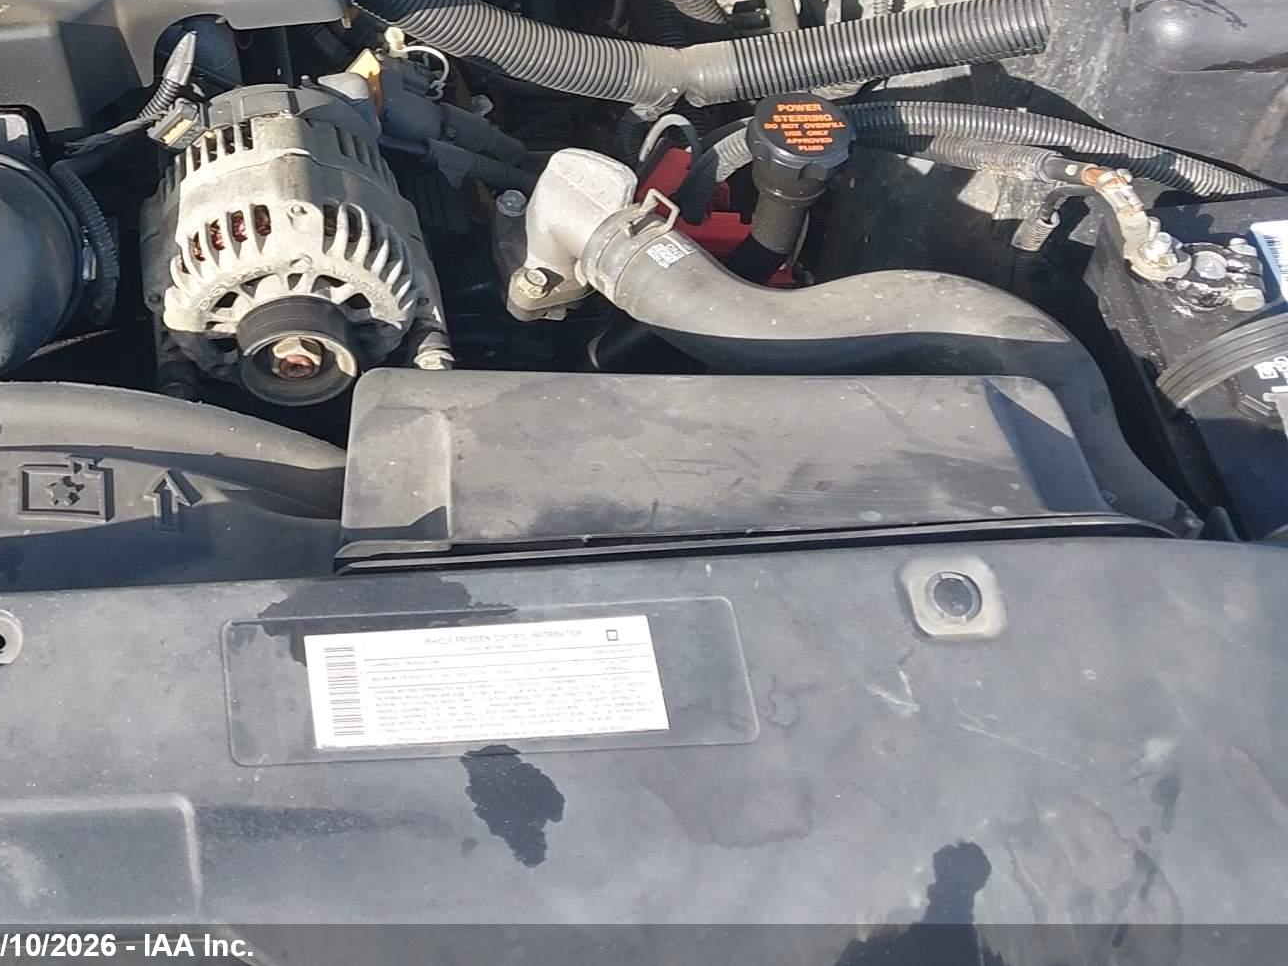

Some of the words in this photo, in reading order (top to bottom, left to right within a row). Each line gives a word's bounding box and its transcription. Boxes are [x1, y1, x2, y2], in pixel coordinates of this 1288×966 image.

[777, 103, 822, 112] POWER
[772, 114, 833, 123] STEERING
[803, 121, 846, 129] OVERFILL
